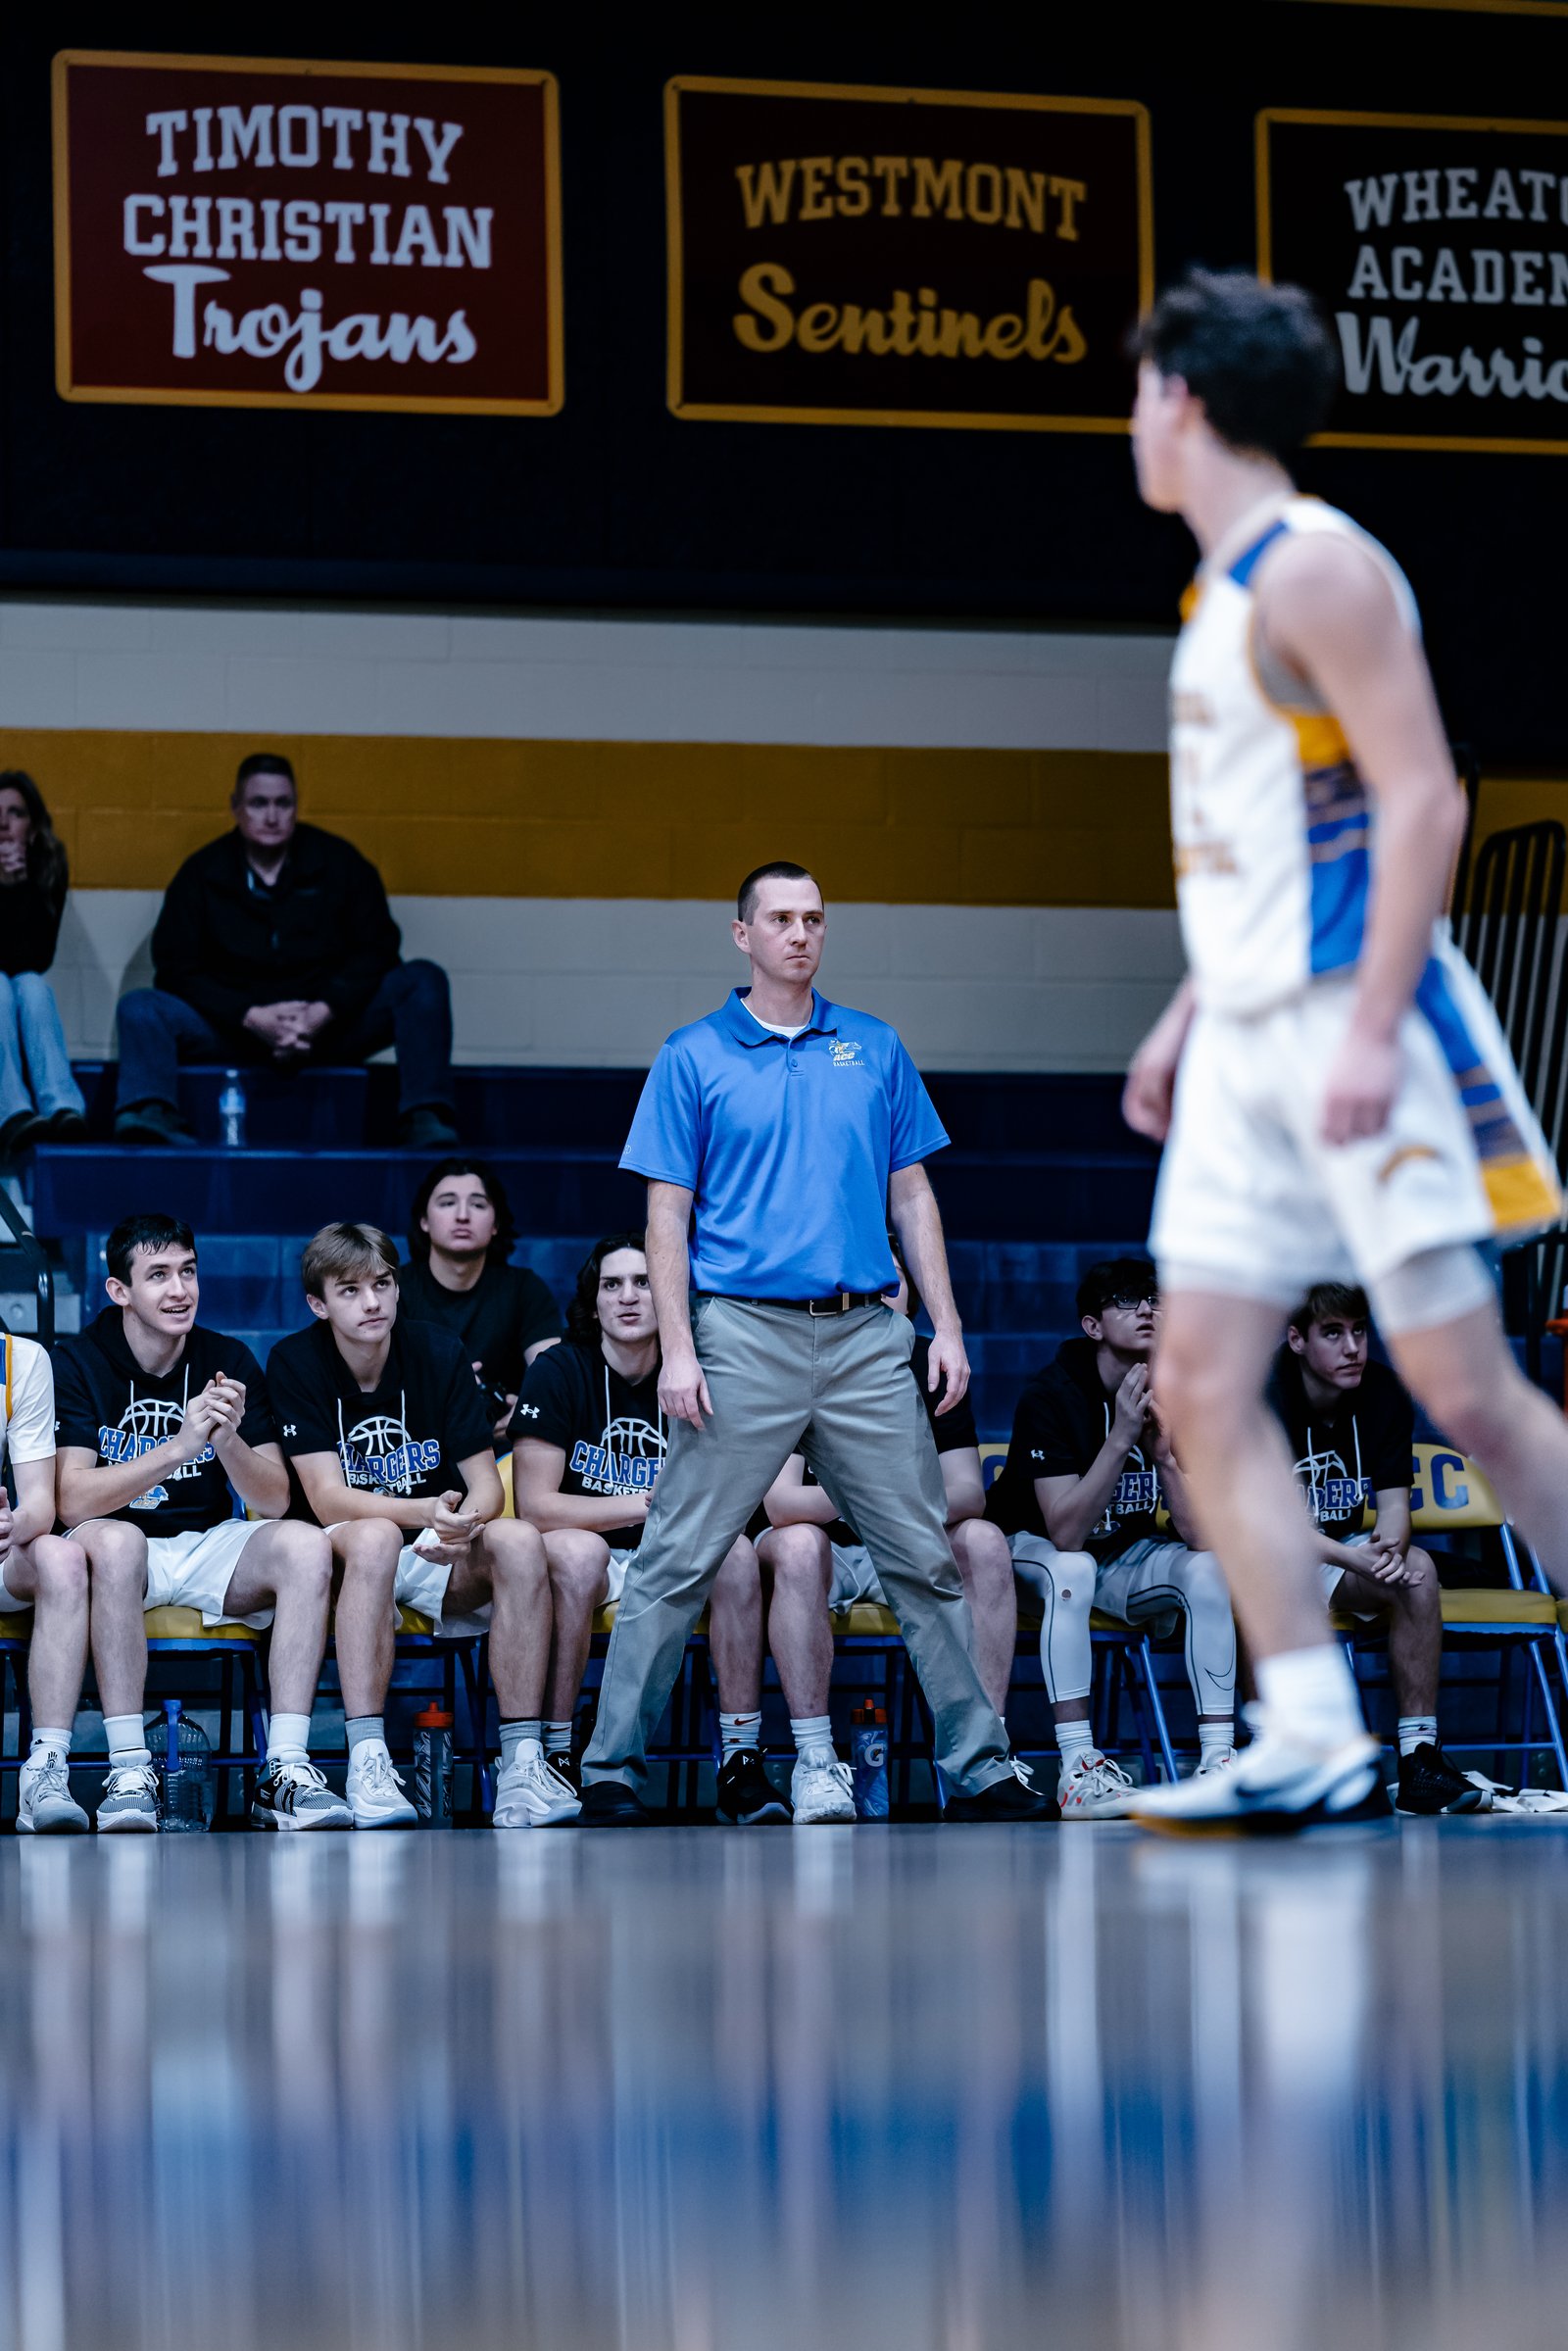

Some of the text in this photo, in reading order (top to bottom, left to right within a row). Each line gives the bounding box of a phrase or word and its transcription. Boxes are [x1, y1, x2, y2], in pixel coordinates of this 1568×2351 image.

[146, 104, 464, 184] TIMOTHY
[123, 194, 493, 269] CHRISTIAN
[735, 156, 1087, 241] WESTMONT
[1344, 168, 1568, 232] WHEAT
[142, 264, 477, 392] Trojans
[732, 262, 1087, 364] Sentinels
